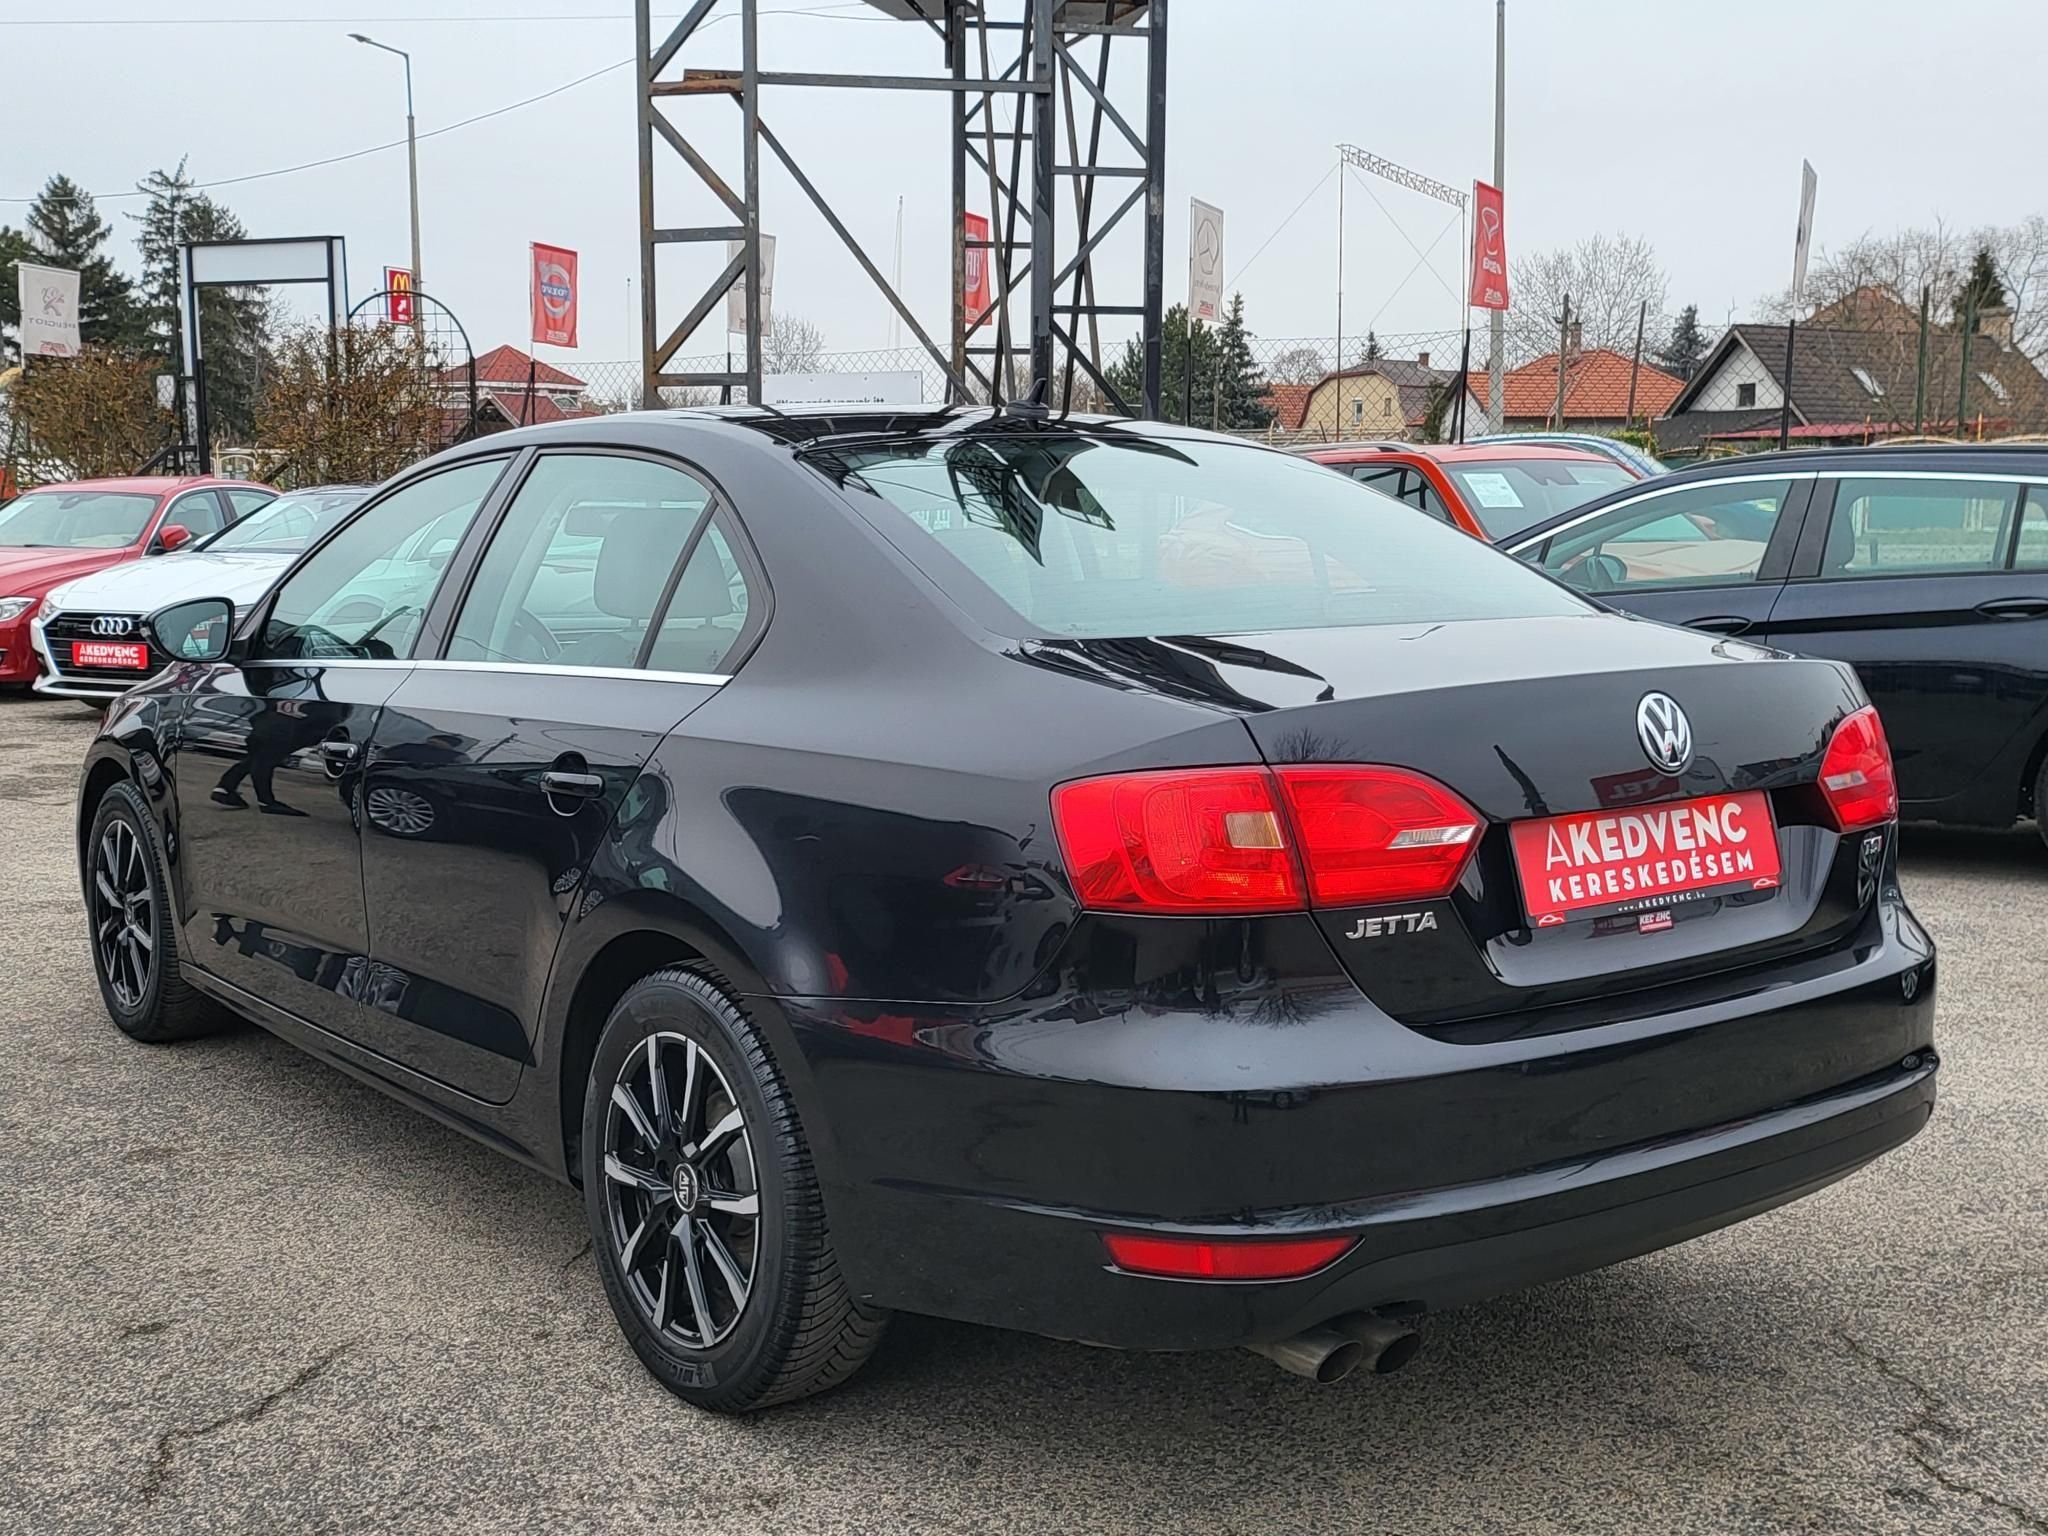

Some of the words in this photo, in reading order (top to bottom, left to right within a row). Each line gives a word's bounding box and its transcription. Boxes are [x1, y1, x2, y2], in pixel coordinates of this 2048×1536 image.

[79, 644, 139, 658] AKEDVENC
[1546, 802, 1748, 871] AKEDVENC
[1548, 848, 1755, 904] KERESKEDÉSEM
[1345, 911, 1438, 939] JETTA
